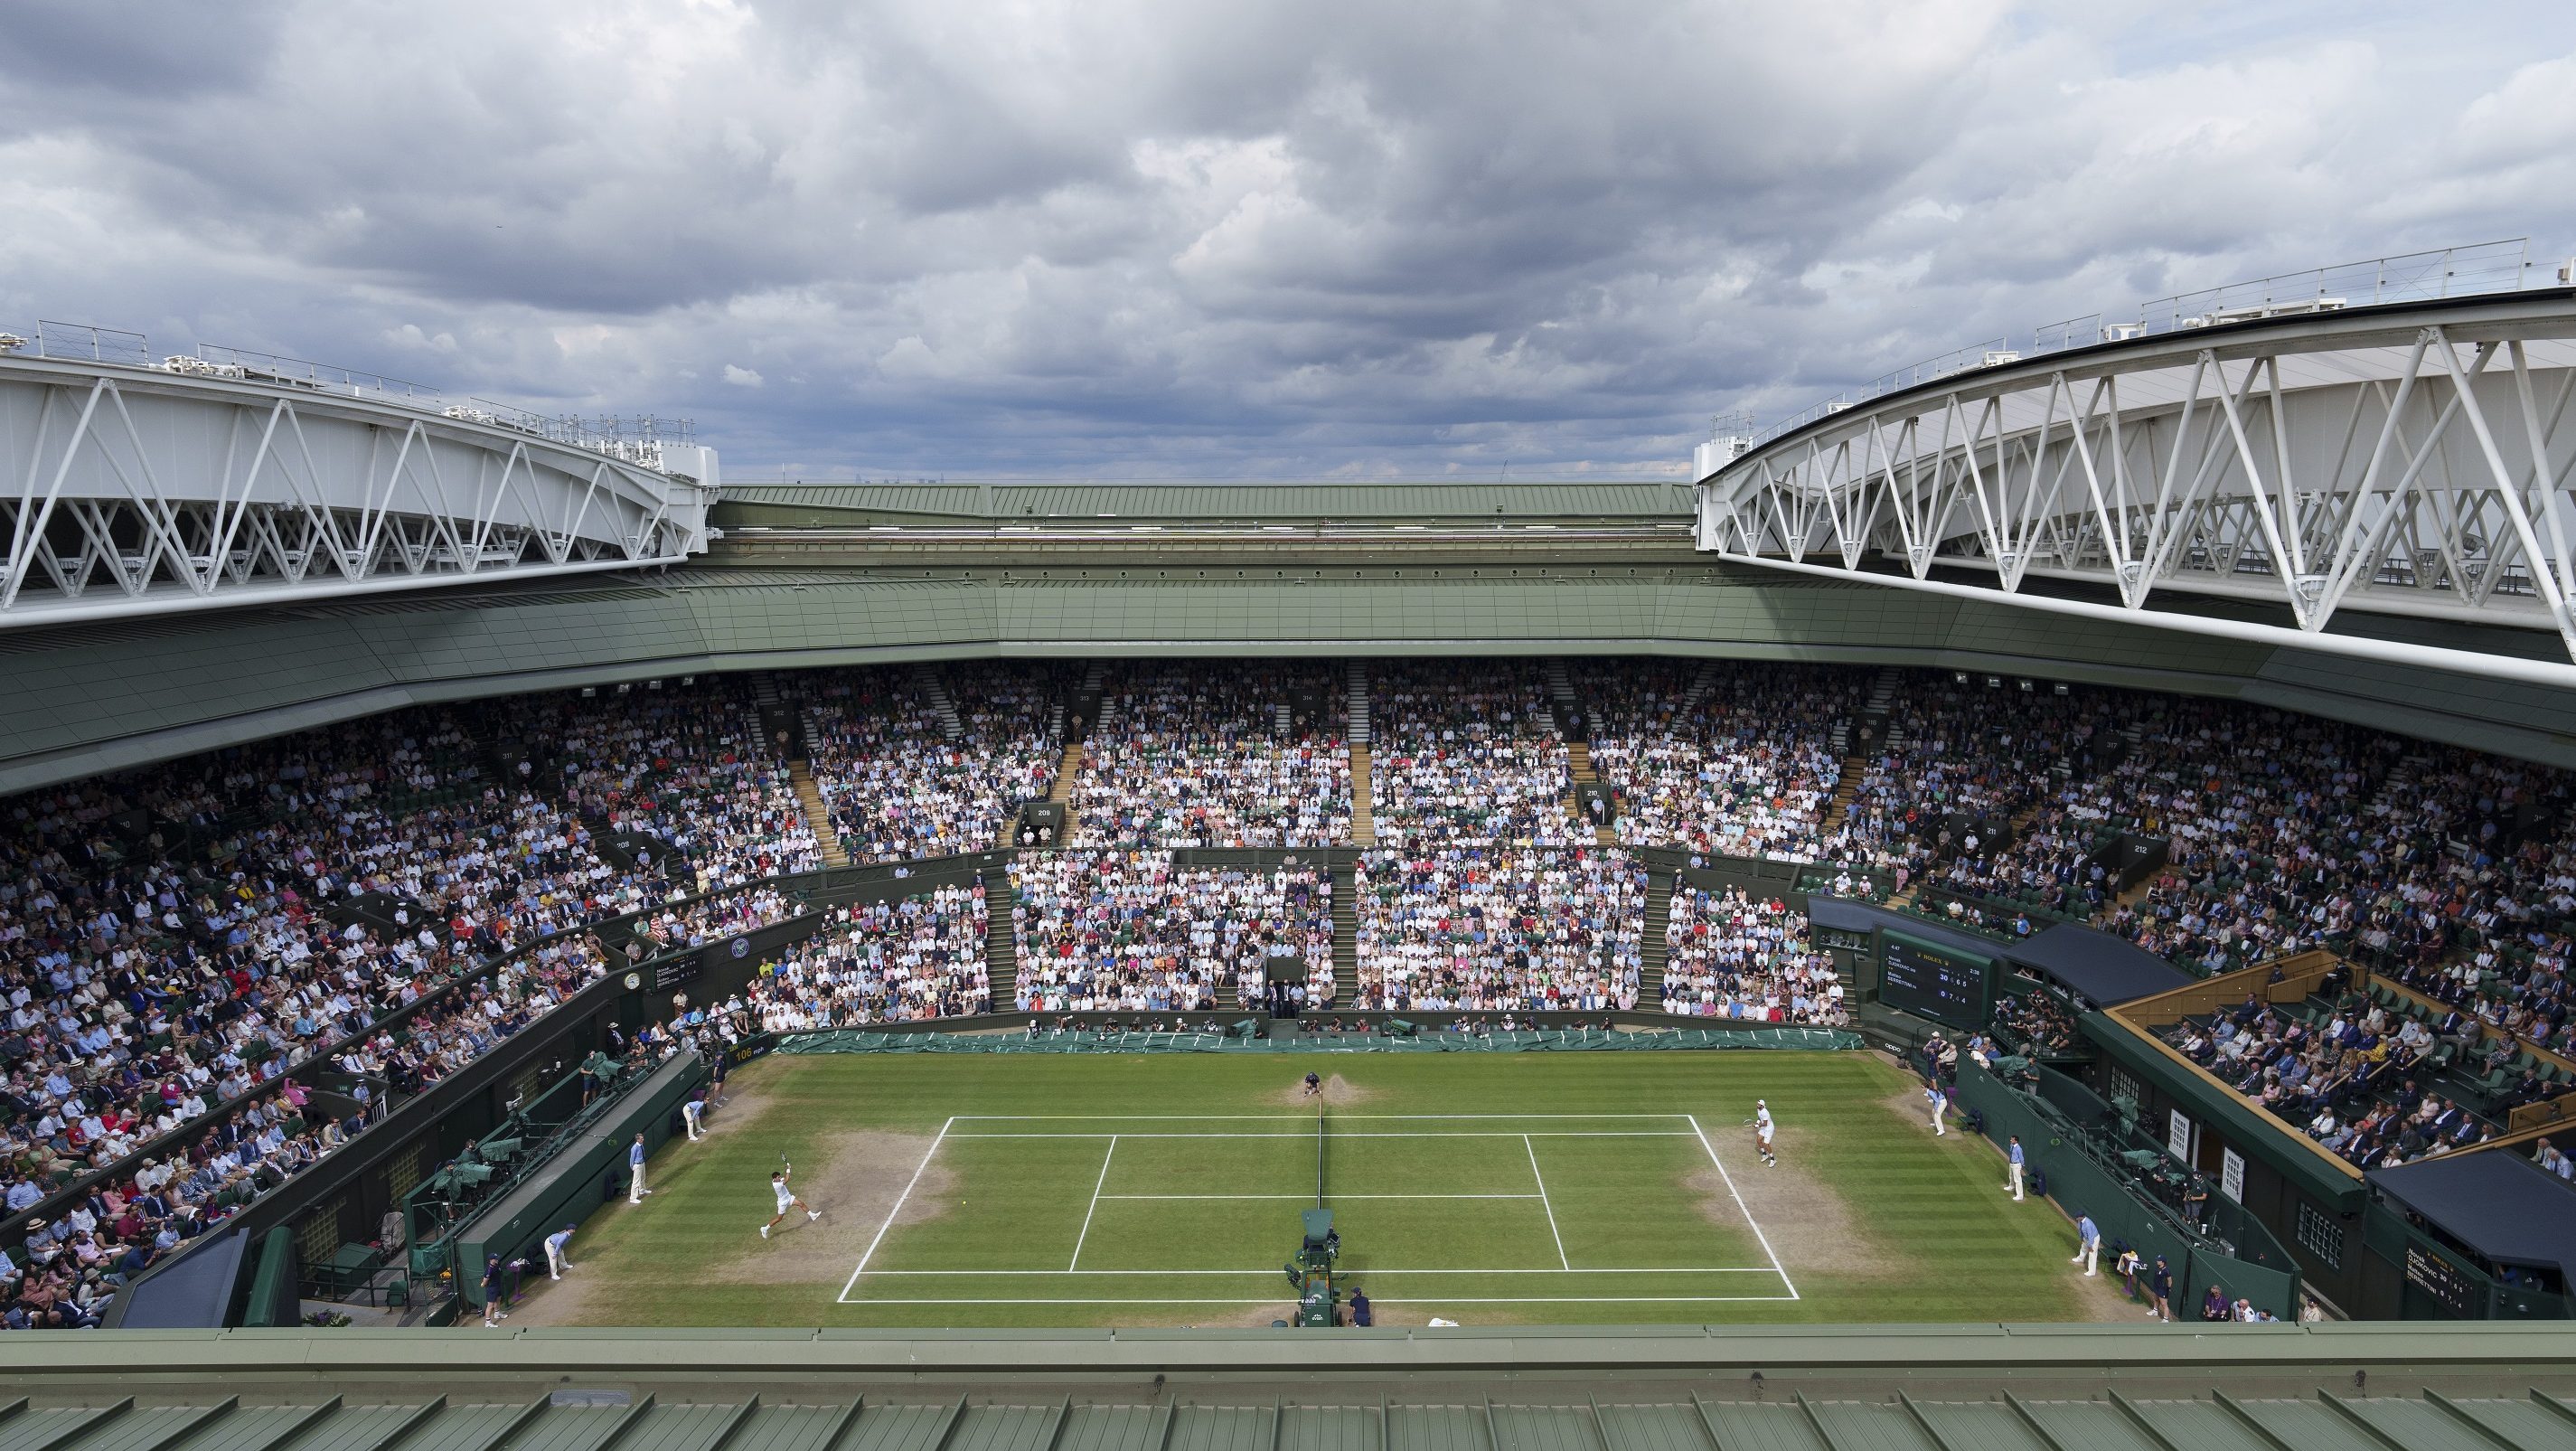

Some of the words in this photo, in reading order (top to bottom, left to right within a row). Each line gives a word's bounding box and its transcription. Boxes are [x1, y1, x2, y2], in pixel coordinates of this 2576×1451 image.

[1987, 827, 1997, 835] 211
[2134, 845, 2148, 854] 212
[1923, 954, 1942, 965] ROLEX
[1940, 974, 1949, 982] 30
[1885, 1042, 1902, 1052] oppo
[736, 1047, 752, 1061] 106
[2408, 1248, 2425, 1264] Novak
[2408, 1255, 2438, 1278] DJOKOVIC
[2407, 1269, 2437, 1295] BERRETTINI
